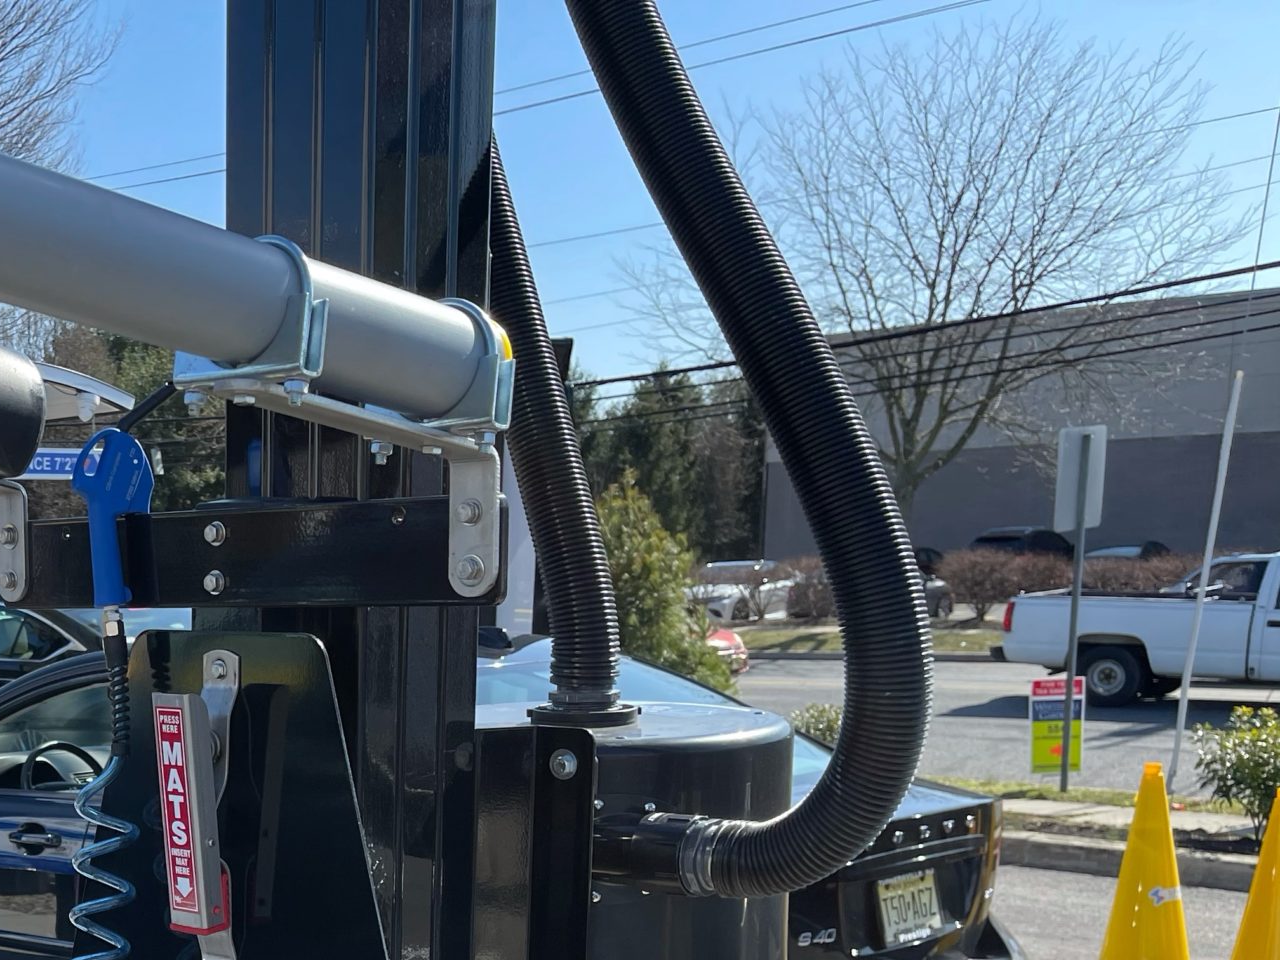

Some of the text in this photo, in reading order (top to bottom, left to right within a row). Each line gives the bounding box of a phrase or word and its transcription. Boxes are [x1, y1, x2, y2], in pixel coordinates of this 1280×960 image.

[159, 714, 180, 725] PRESS
[162, 724, 179, 734] HERE
[162, 741, 188, 846] MATS
[171, 848, 191, 858] INSERT
[175, 857, 187, 867] MAT
[175, 866, 190, 876] HERE
